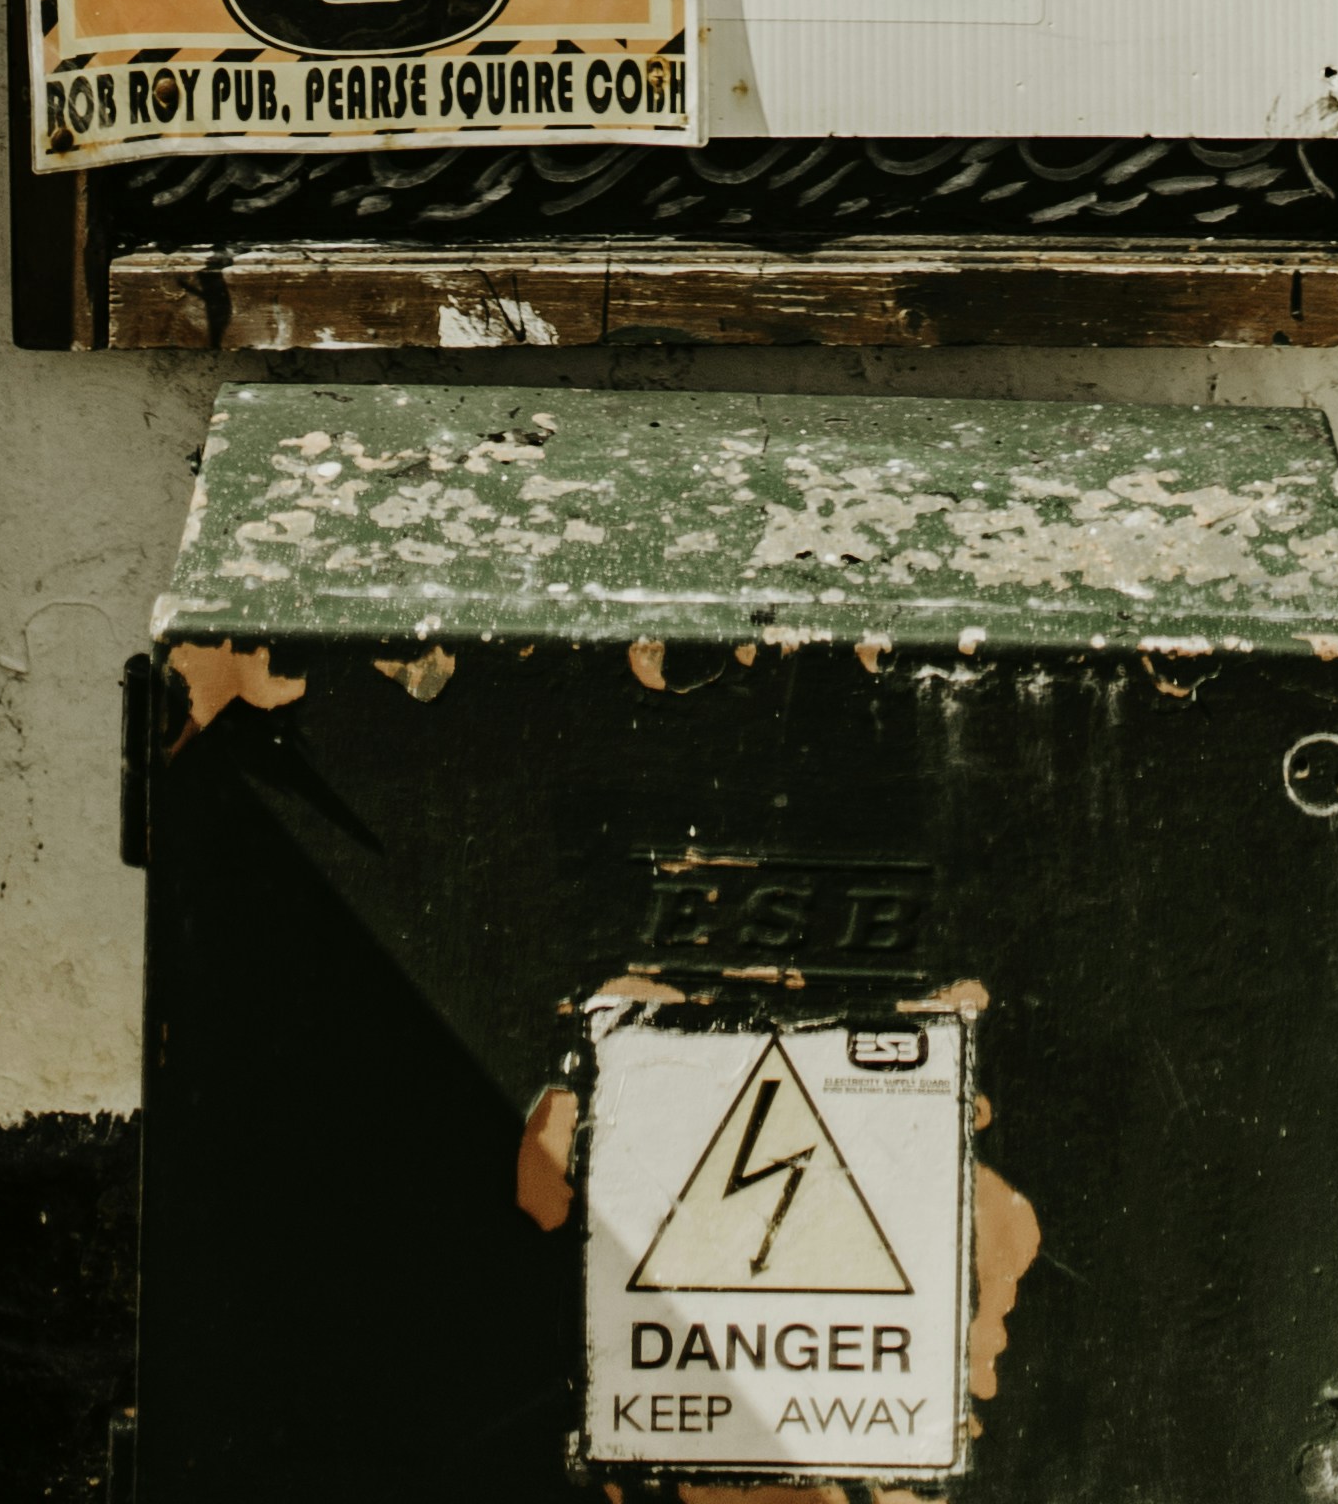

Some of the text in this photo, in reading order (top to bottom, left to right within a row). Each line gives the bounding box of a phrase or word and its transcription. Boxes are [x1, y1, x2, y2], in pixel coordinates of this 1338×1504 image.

[46, 74, 117, 136] ROB
[129, 68, 201, 124] ROY
[306, 63, 426, 122] PEARSE
[441, 60, 572, 119] SQUARE
[641, 883, 917, 949] ESB
[855, 1032, 919, 1062] ESB
[632, 1323, 911, 1374] DANGER
[613, 1395, 927, 1437] KEEP AWAY
